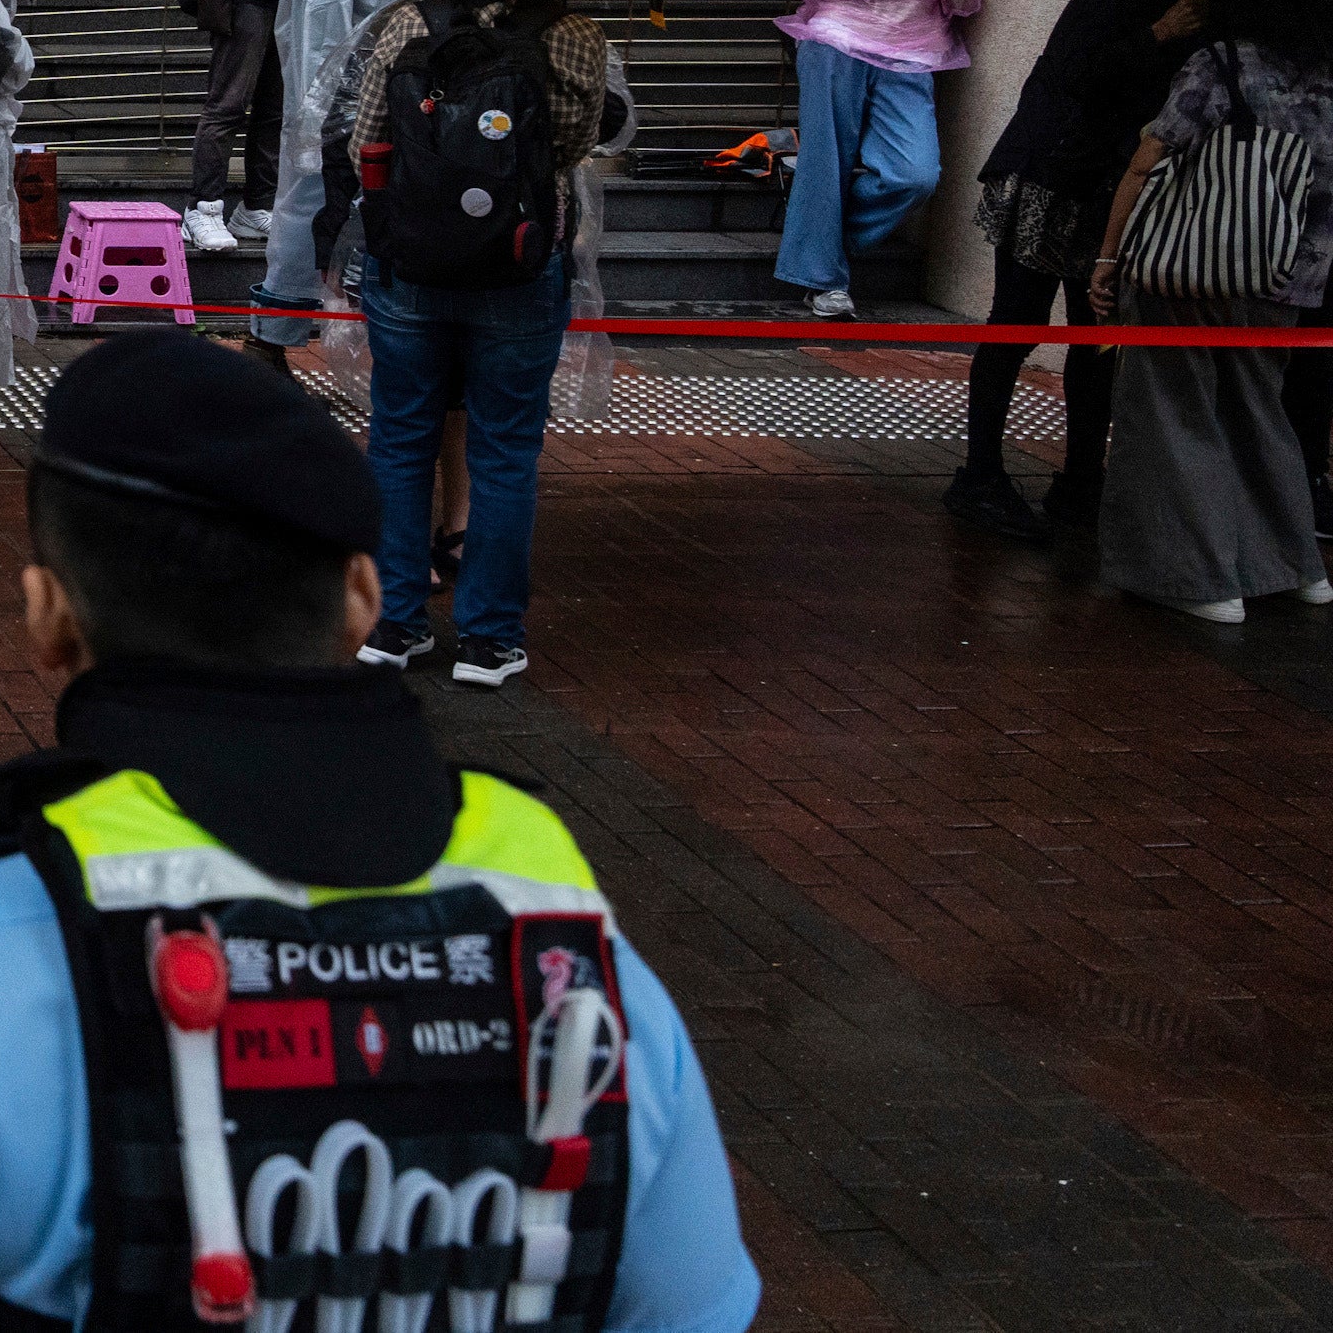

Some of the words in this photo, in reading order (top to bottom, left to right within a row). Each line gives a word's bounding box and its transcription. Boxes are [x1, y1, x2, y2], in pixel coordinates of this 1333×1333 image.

[225, 936, 273, 993] 警
[276, 939, 442, 985] POLICE
[443, 933, 495, 985] 察
